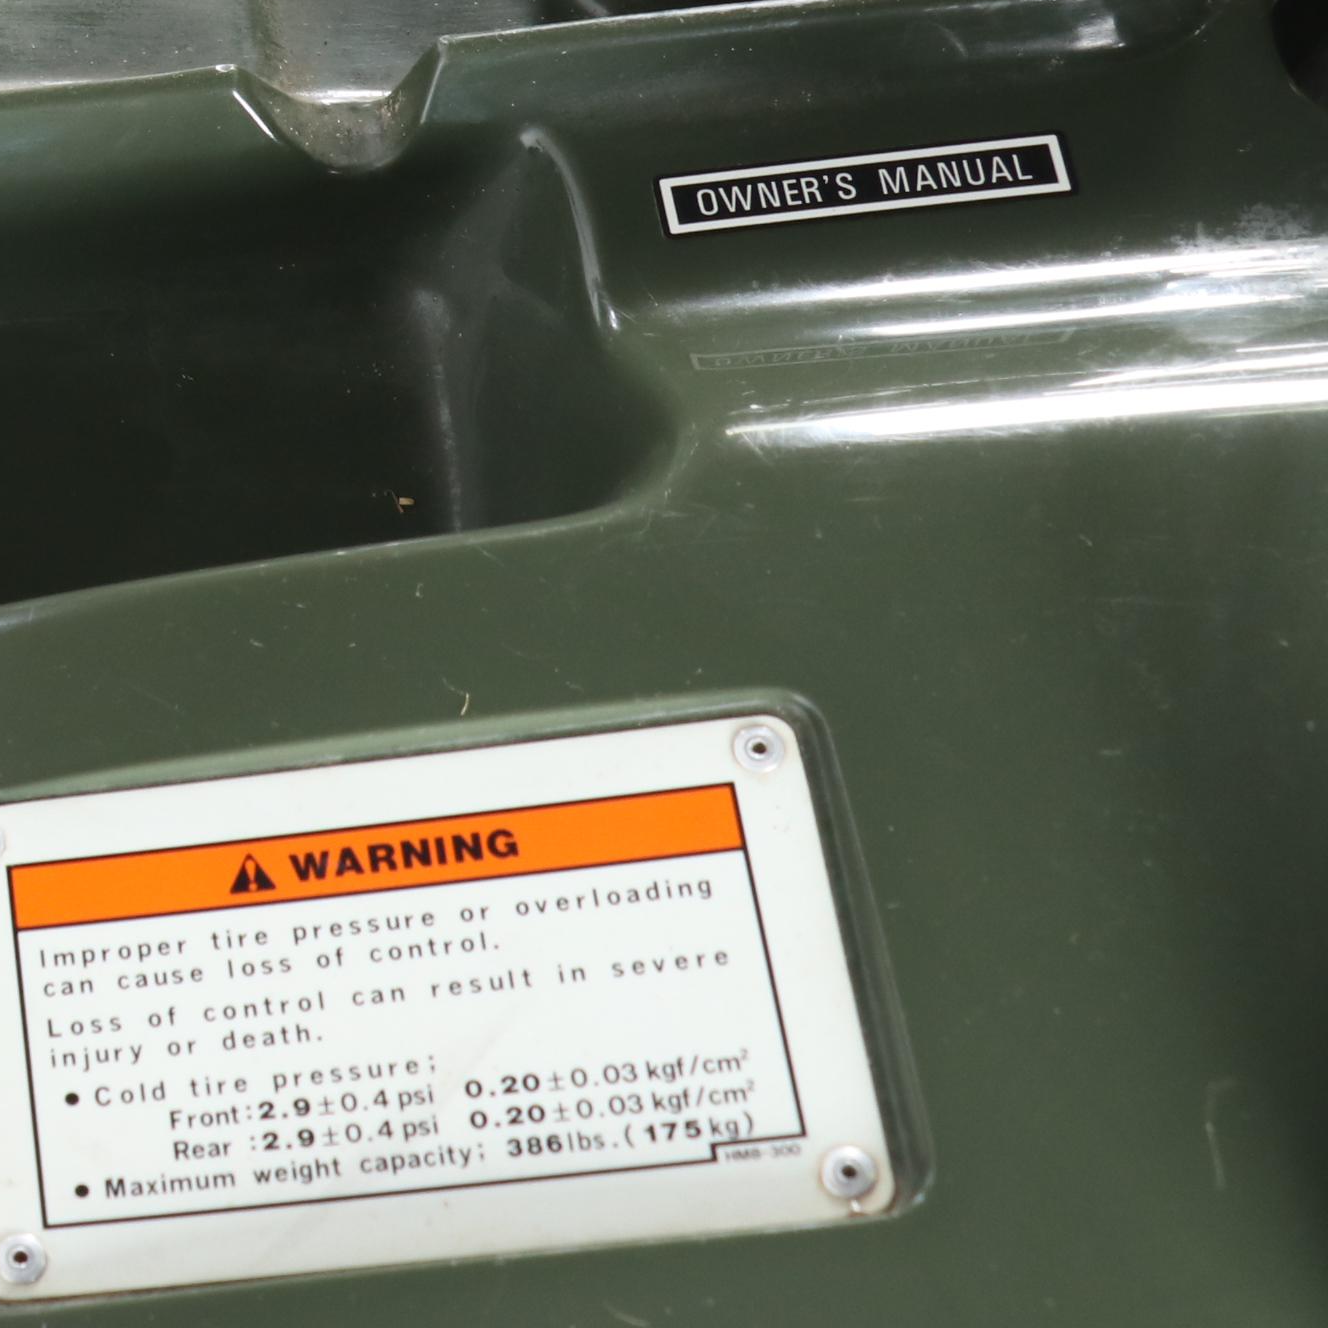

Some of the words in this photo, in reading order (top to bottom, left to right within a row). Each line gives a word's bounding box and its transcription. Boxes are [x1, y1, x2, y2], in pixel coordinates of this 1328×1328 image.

[696, 172, 857, 216] OWNER'S
[879, 154, 1033, 195] MANUAL
[288, 828, 519, 883] WARNING
[39, 938, 186, 969] Improper
[210, 929, 268, 951] tire
[292, 912, 435, 946] pressure
[459, 904, 489, 923] or
[515, 877, 713, 918] overloading
[43, 978, 94, 998] can
[117, 966, 203, 991] cause
[227, 958, 292, 979] loss
[316, 946, 344, 969] of
[369, 931, 499, 964] control.
[47, 1016, 122, 1038] Loss
[147, 1005, 176, 1028] of
[203, 991, 325, 1023] control
[351, 986, 405, 1007] can
[430, 968, 532, 999] result
[558, 963, 586, 984] in
[611, 948, 729, 978] severe
[50, 1042, 143, 1073] injury
[167, 1039, 196, 1057] or
[222, 1022, 323, 1052] death.
[94, 1079, 167, 1108] Cold
[189, 1077, 248, 1099] tire
[104, 1172, 236, 1200] Maximum
[253, 1157, 342, 1186] weight
